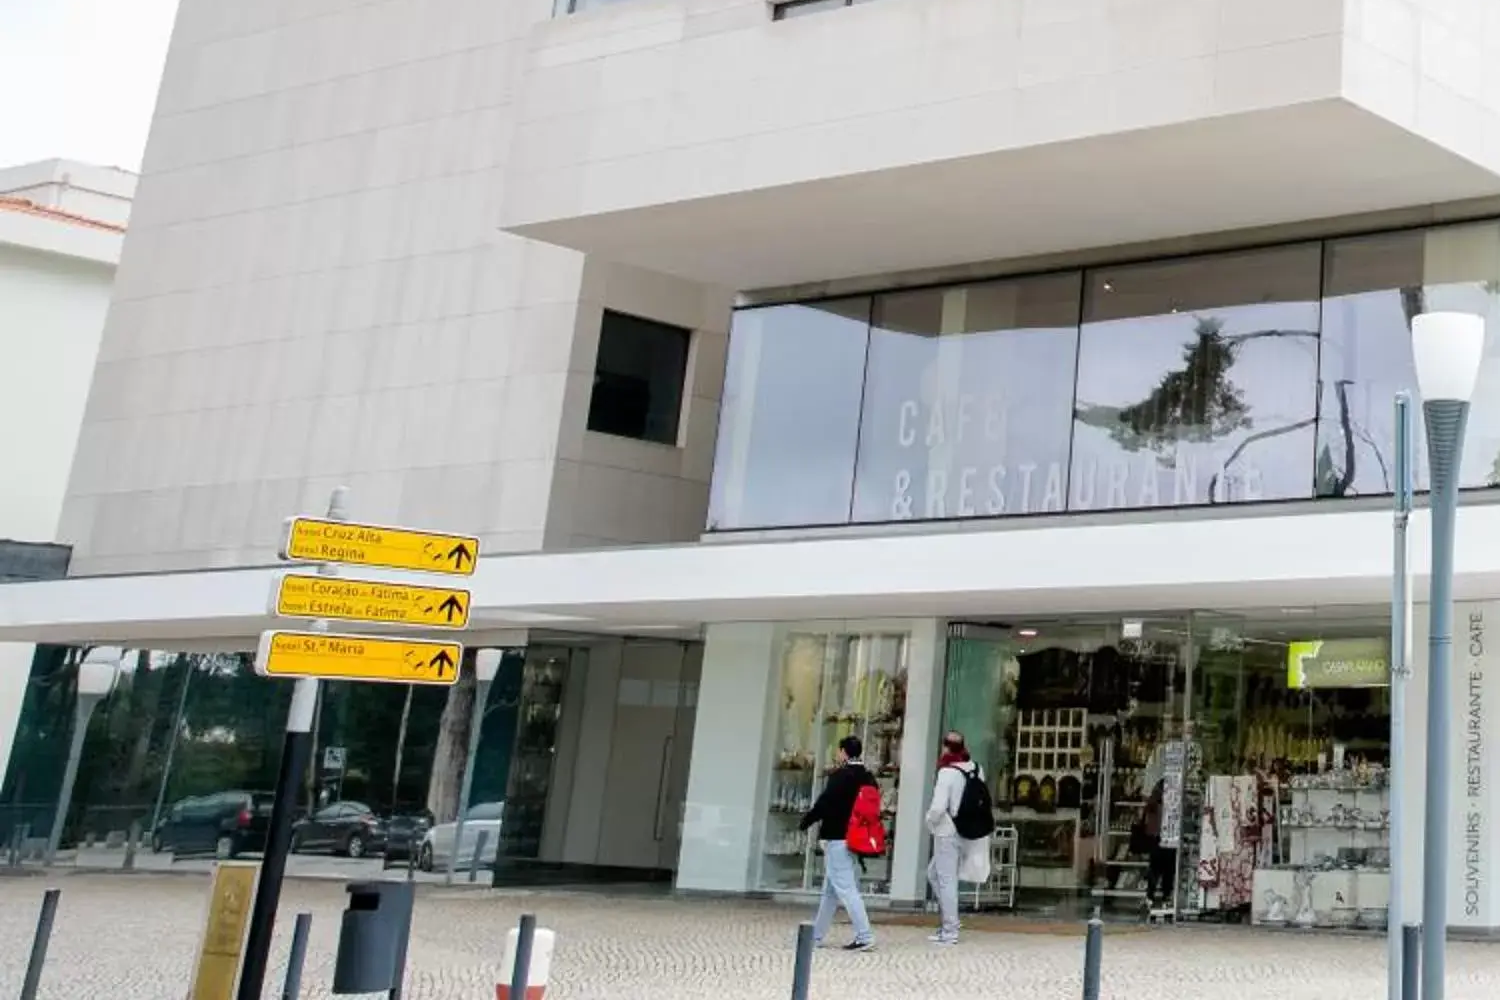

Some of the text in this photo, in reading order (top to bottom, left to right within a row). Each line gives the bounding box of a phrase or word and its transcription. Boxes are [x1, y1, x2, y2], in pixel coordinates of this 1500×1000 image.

[323, 527, 354, 540] Cruz
[355, 530, 382, 543] Alta
[321, 544, 365, 560] Regina
[311, 581, 359, 598] Coração
[309, 600, 352, 615] Estrela
[328, 640, 365, 655] Maria
[1467, 670, 1484, 798] RESTAURANTE
[1465, 811, 1481, 917] SOUVENIRS
